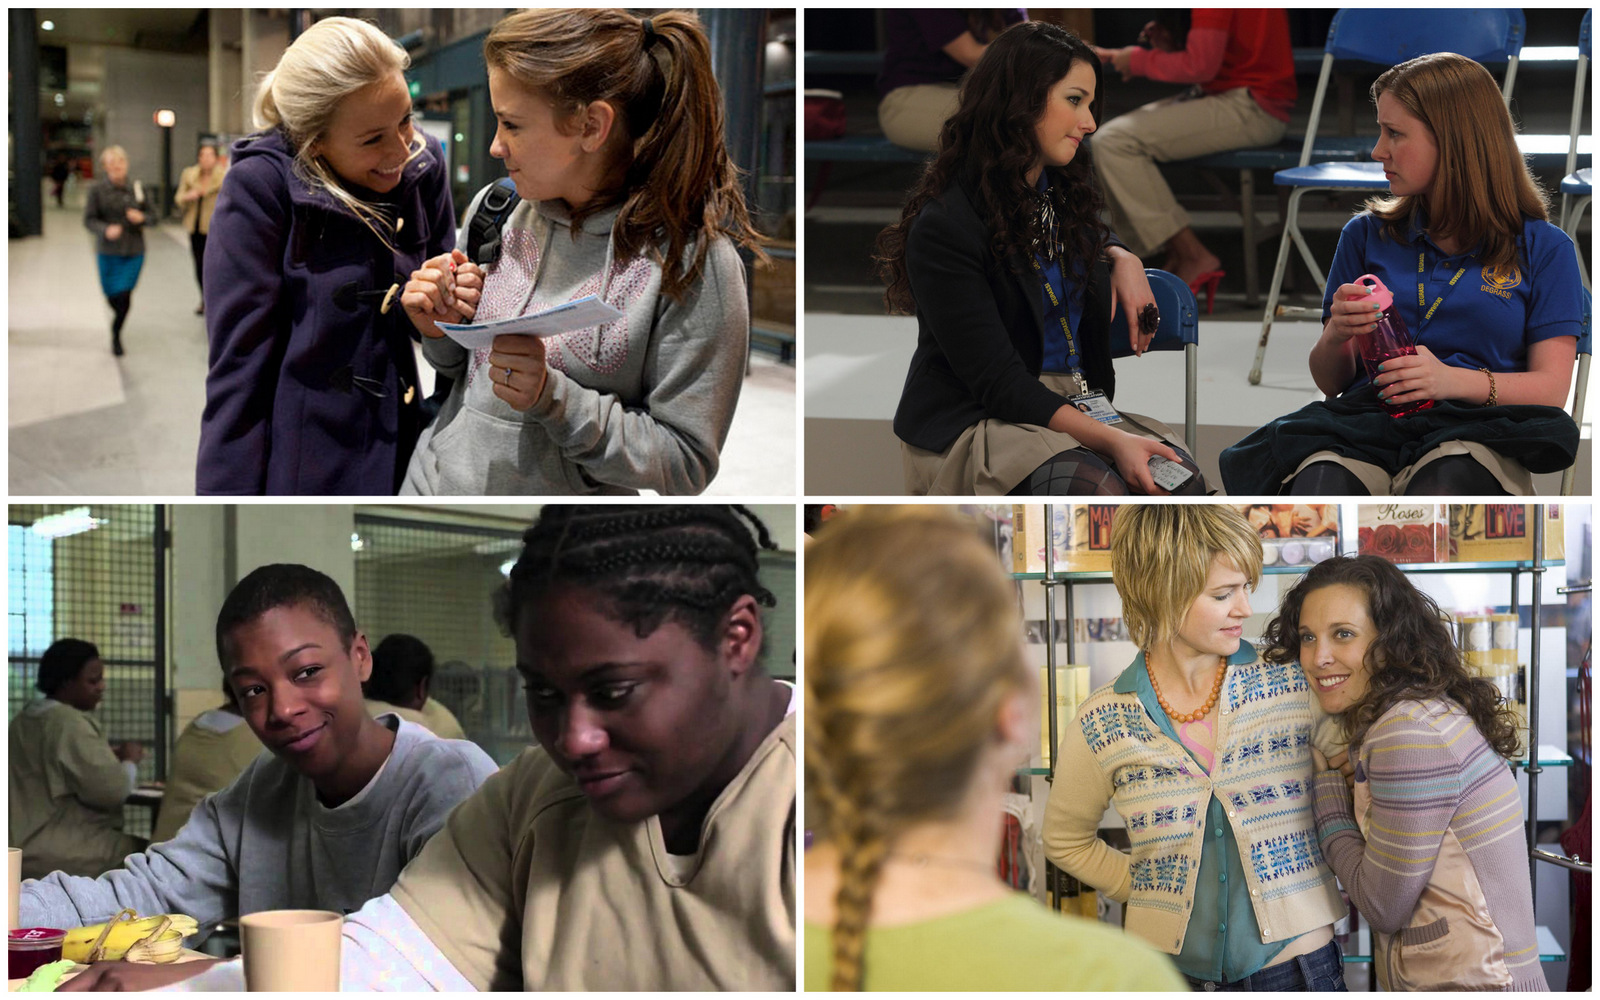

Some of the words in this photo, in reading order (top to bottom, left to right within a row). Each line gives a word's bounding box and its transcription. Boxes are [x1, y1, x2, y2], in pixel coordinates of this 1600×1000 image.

[1480, 284, 1512, 300] DEGRASSI
[1377, 503, 1424, 520] Roses
[1487, 512, 1524, 537] LOVE
